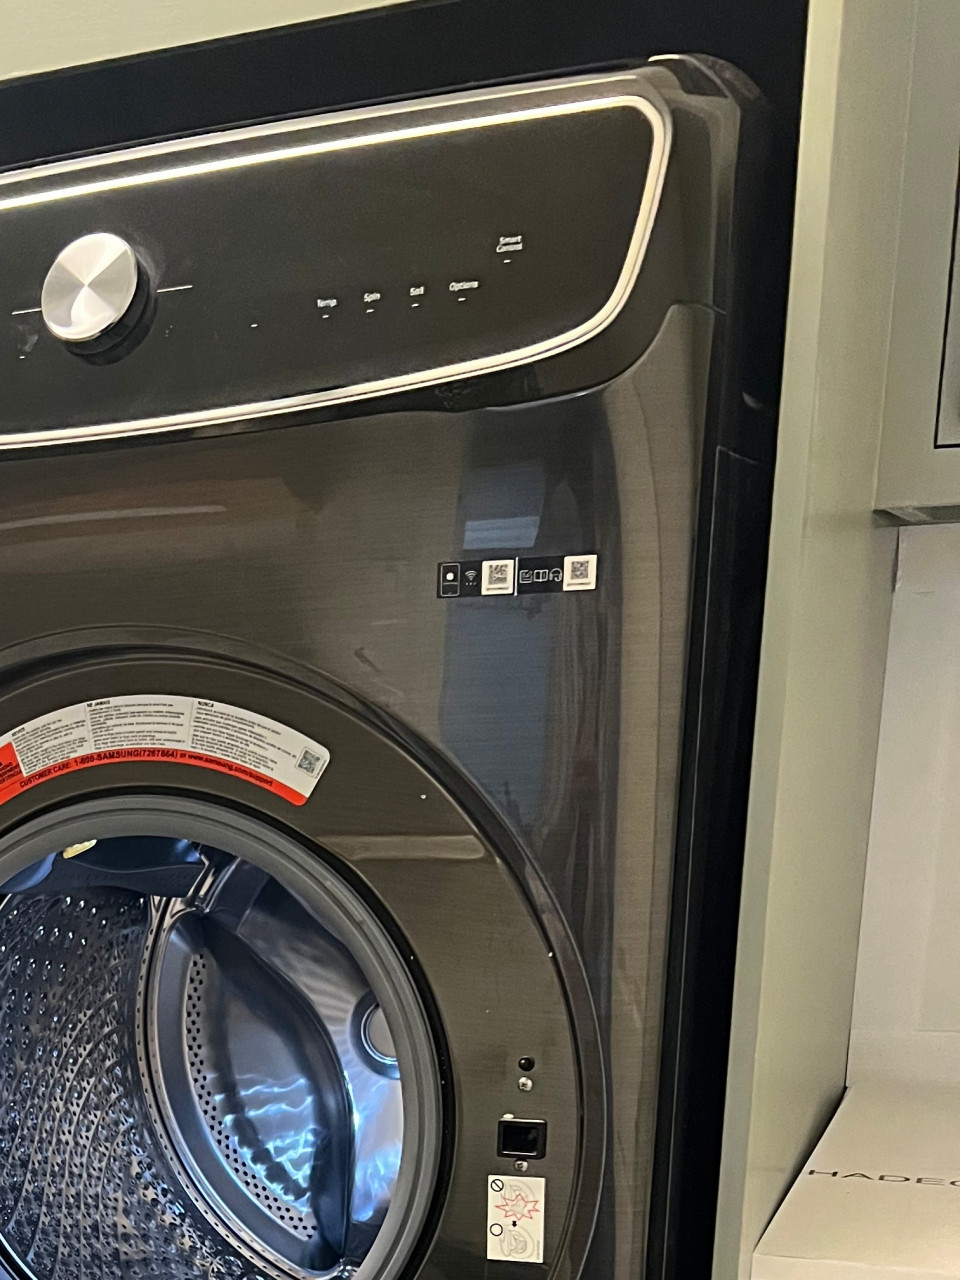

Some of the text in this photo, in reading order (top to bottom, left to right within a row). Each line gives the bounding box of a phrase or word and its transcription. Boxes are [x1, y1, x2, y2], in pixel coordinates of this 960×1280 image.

[449, 281, 479, 291] Options
[363, 292, 381, 302] Spin
[317, 299, 338, 308] Temp
[19, 768, 53, 788] CUSTOMER
